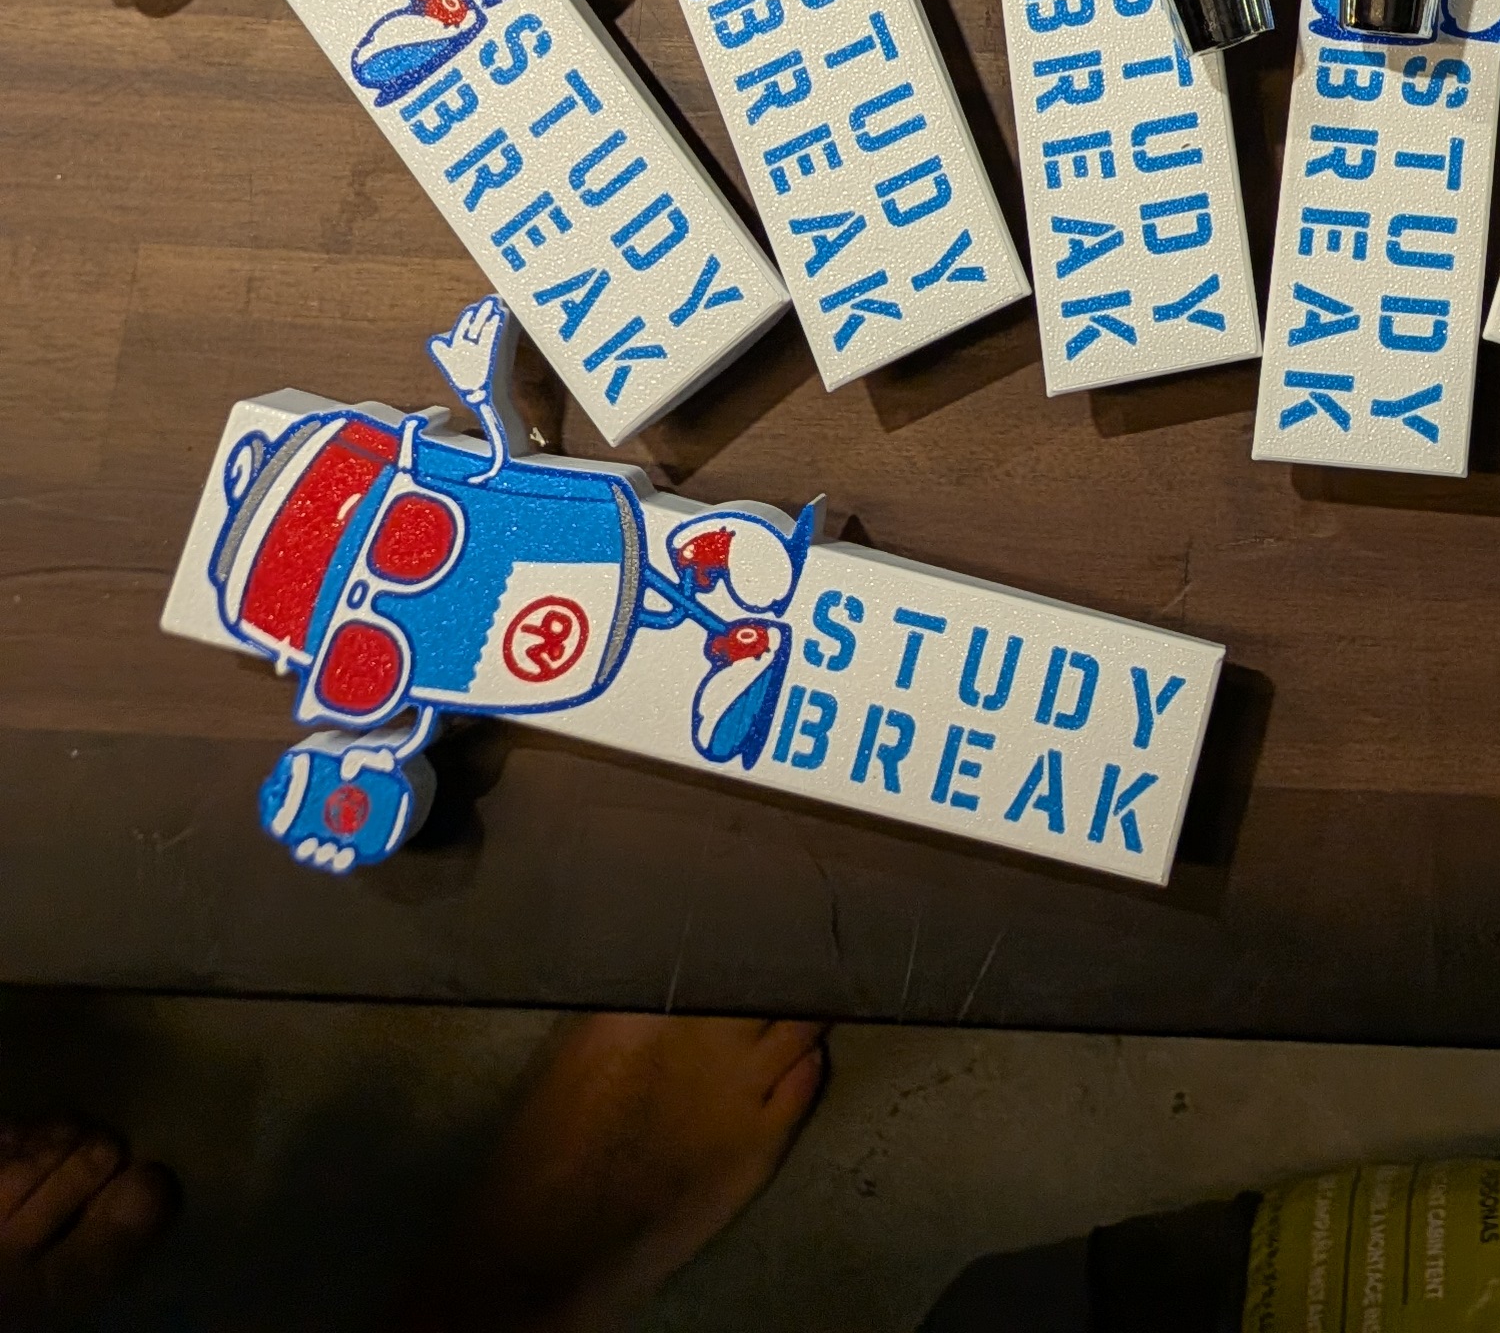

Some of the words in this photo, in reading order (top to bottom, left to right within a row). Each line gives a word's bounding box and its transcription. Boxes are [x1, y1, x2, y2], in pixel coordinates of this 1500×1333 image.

[401, 65, 666, 401] BREAK
[481, 14, 743, 328] STUDY
[1277, 45, 1383, 433] BREAK
[1369, 57, 1471, 444] STUDY
[772, 686, 1159, 854] BREAK
[803, 590, 1187, 750] STUDY
